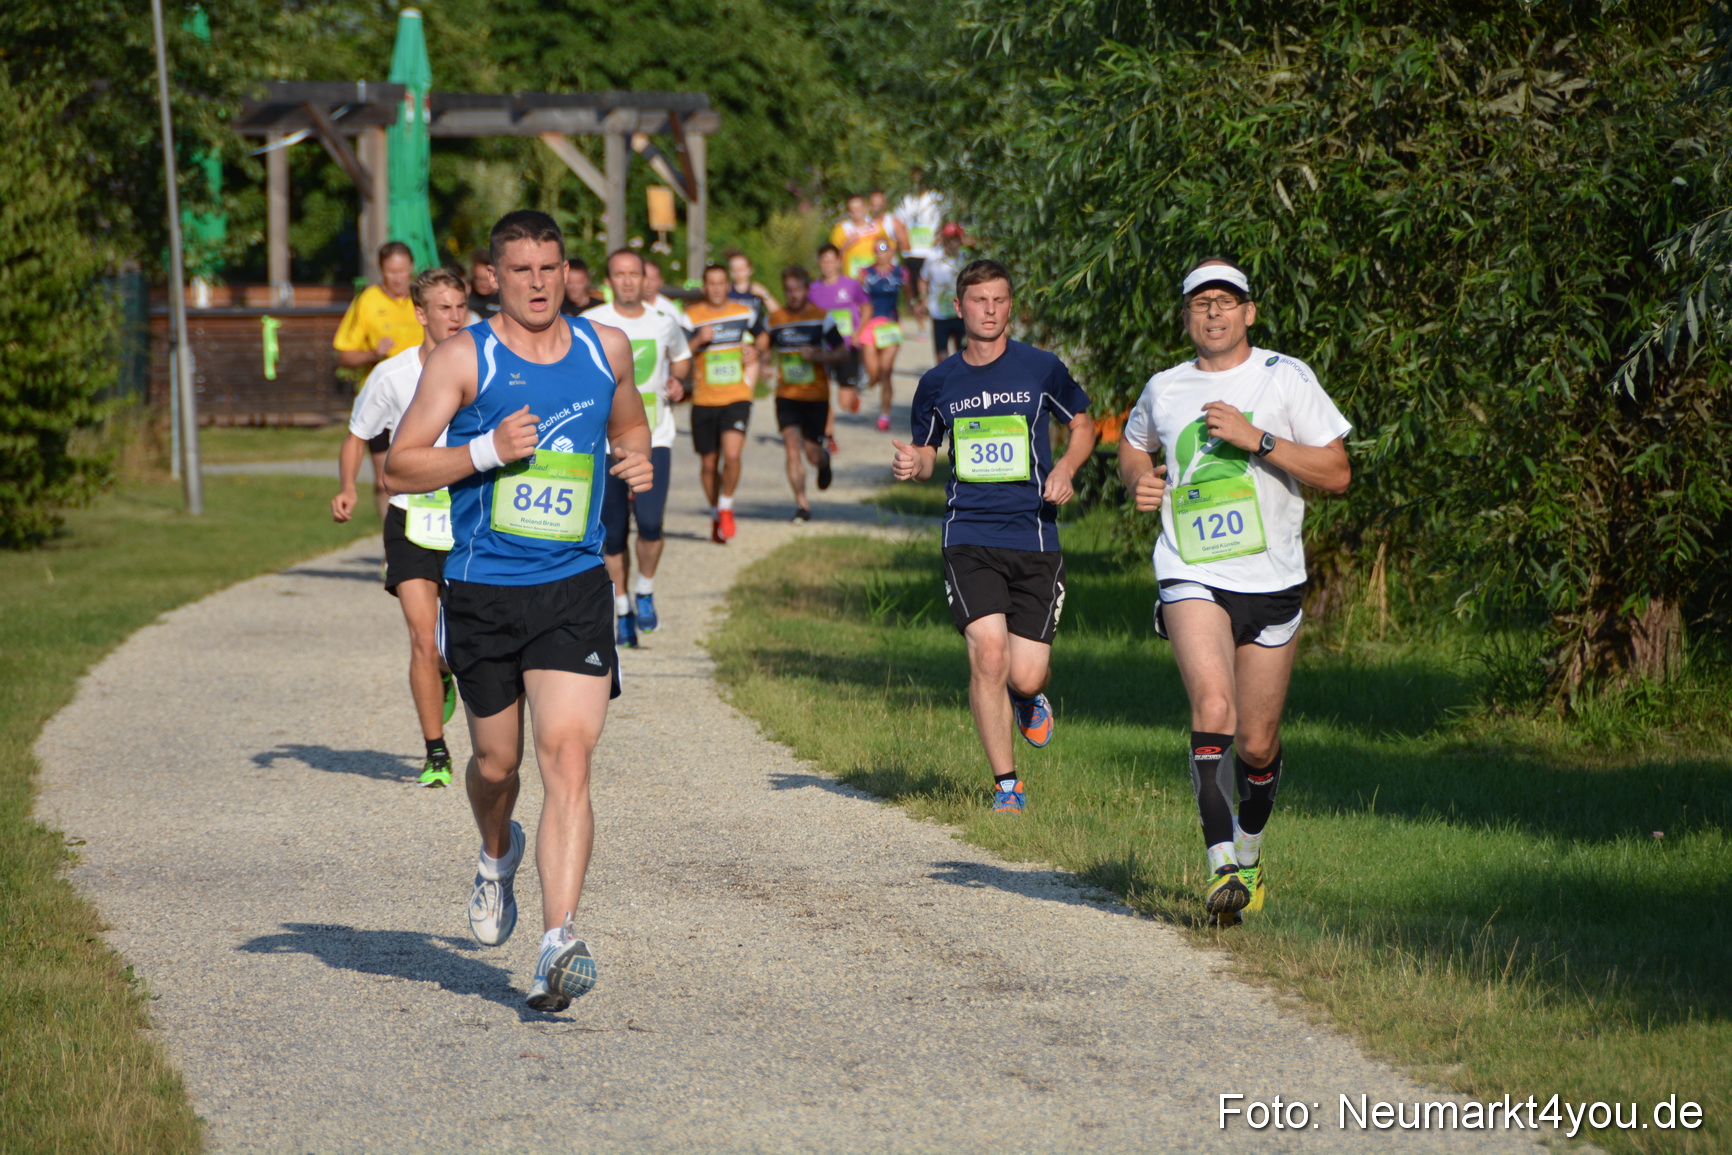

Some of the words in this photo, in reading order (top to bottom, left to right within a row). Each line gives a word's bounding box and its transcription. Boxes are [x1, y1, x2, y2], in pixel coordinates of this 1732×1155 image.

[538, 408, 571, 432] Schick
[572, 398, 595, 412] Bau
[970, 442, 1014, 464] 380
[513, 483, 574, 516] 845
[520, 517, 542, 526] Roland
[542, 520, 560, 528] Braun
[1192, 510, 1244, 541] 120
[1202, 544, 1220, 552] Gerald
